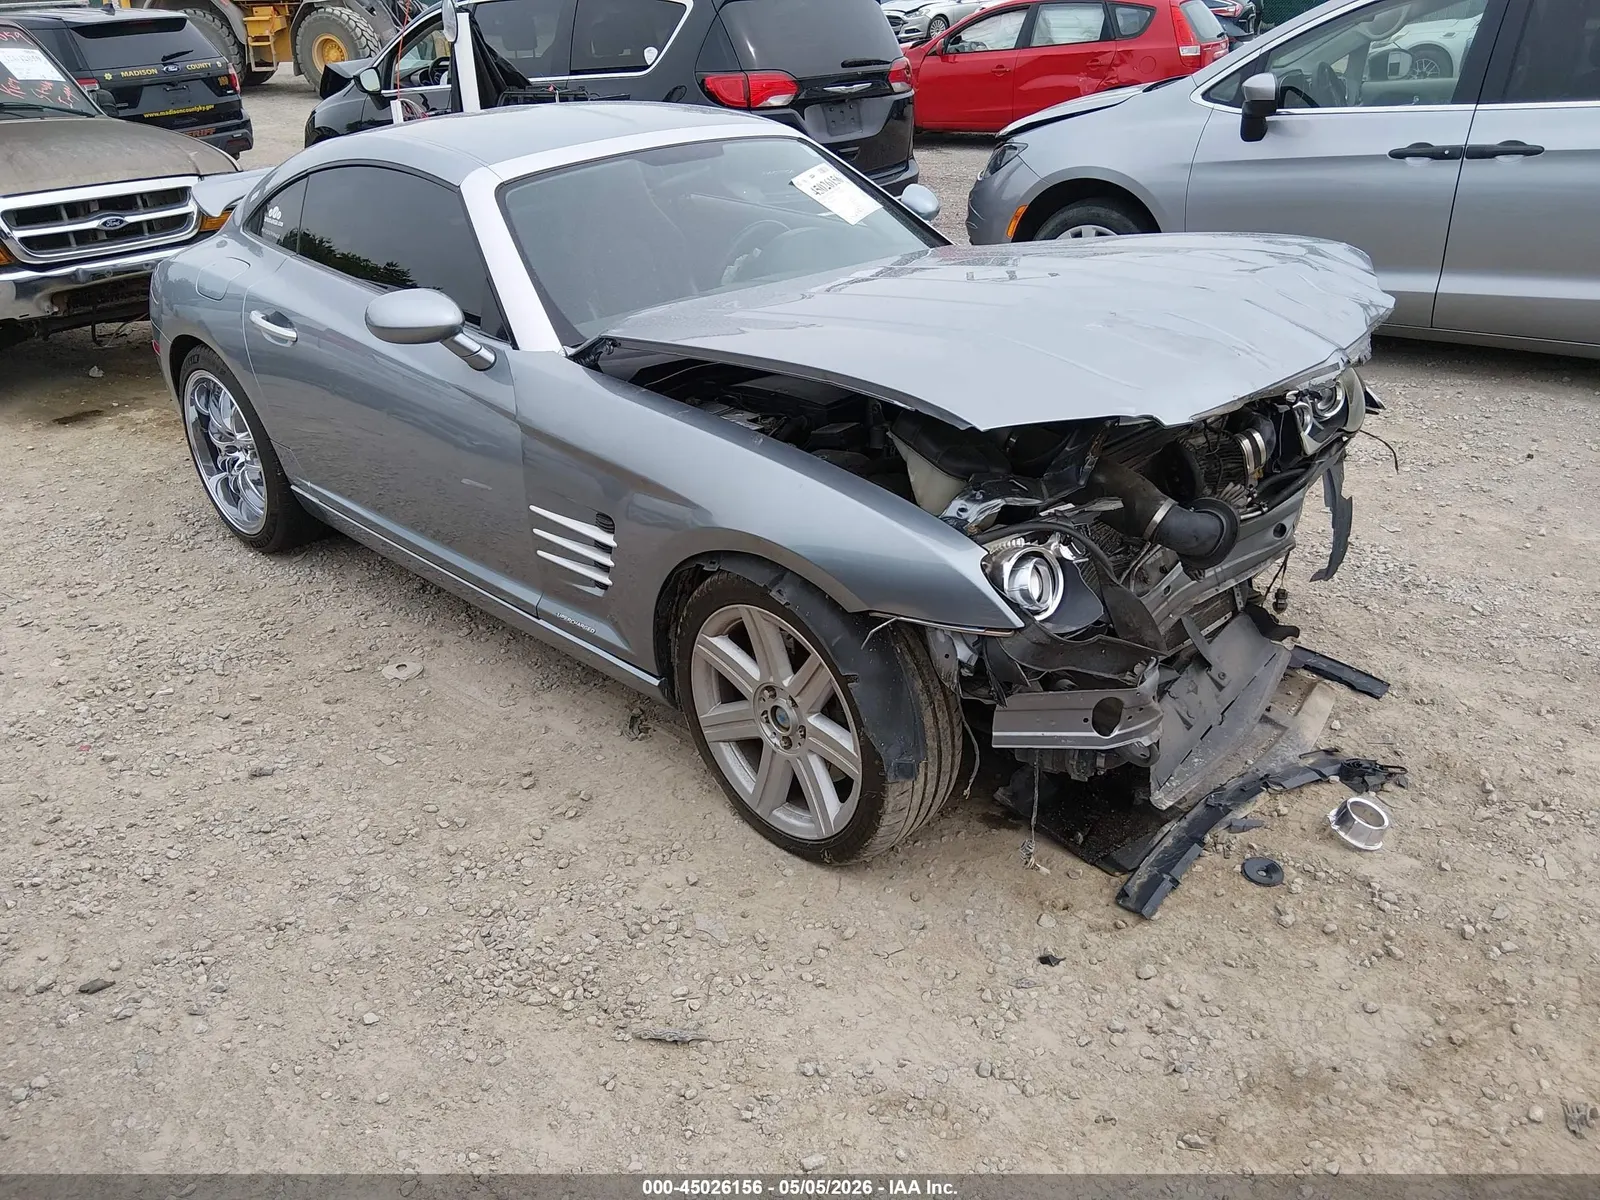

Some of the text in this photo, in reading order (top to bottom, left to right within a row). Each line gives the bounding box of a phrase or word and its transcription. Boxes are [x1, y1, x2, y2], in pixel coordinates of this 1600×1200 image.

[120, 62, 212, 79] MADISON COUNTY
[143, 104, 215, 118] www.madisoncountyky.gov
